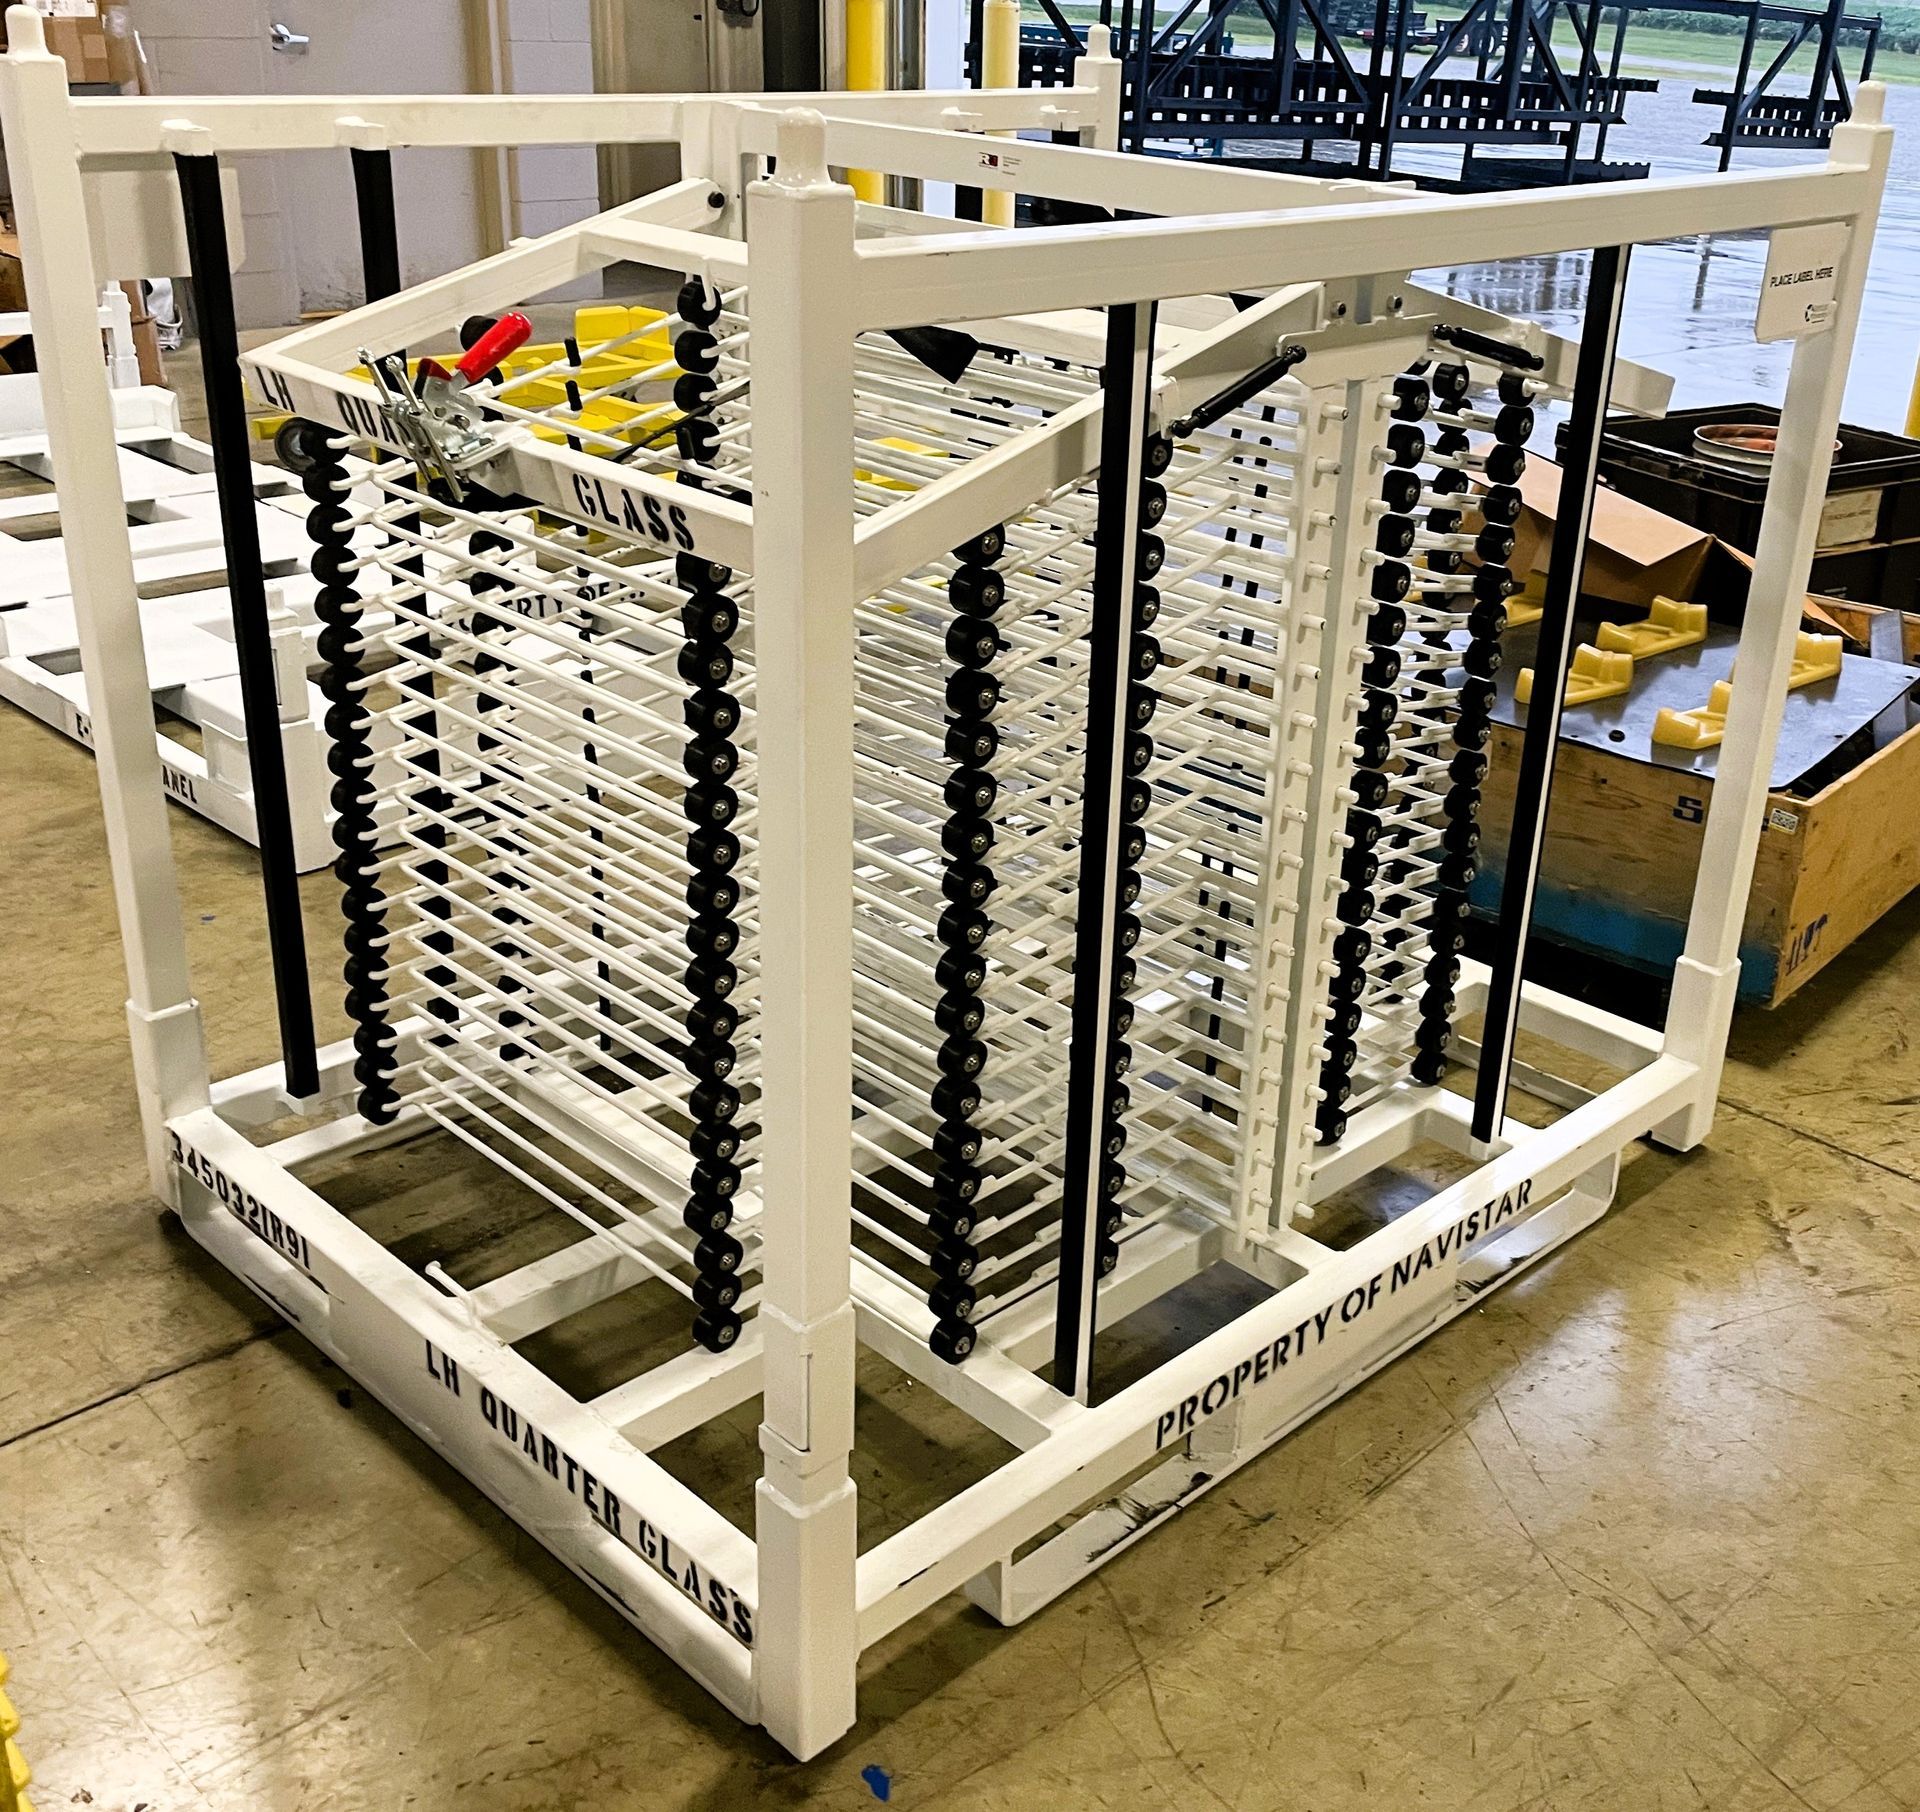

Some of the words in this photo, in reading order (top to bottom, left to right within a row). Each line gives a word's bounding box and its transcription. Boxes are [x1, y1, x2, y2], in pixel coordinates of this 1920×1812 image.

[1769, 273, 1793, 288] PLACE
[1793, 270, 1814, 284] LABEL
[1815, 266, 1834, 280] HERE
[254, 366, 296, 413] LH
[572, 473, 695, 551] GLASS
[162, 764, 198, 805] ANEL
[1155, 1304, 1334, 1451] PROPERTY
[1340, 1273, 1384, 1325] OF
[1390, 1177, 1533, 1297] NAVISTAR
[425, 1338, 461, 1398] LH
[480, 1386, 621, 1536] QUARTER
[638, 1518, 753, 1644] GLASS
